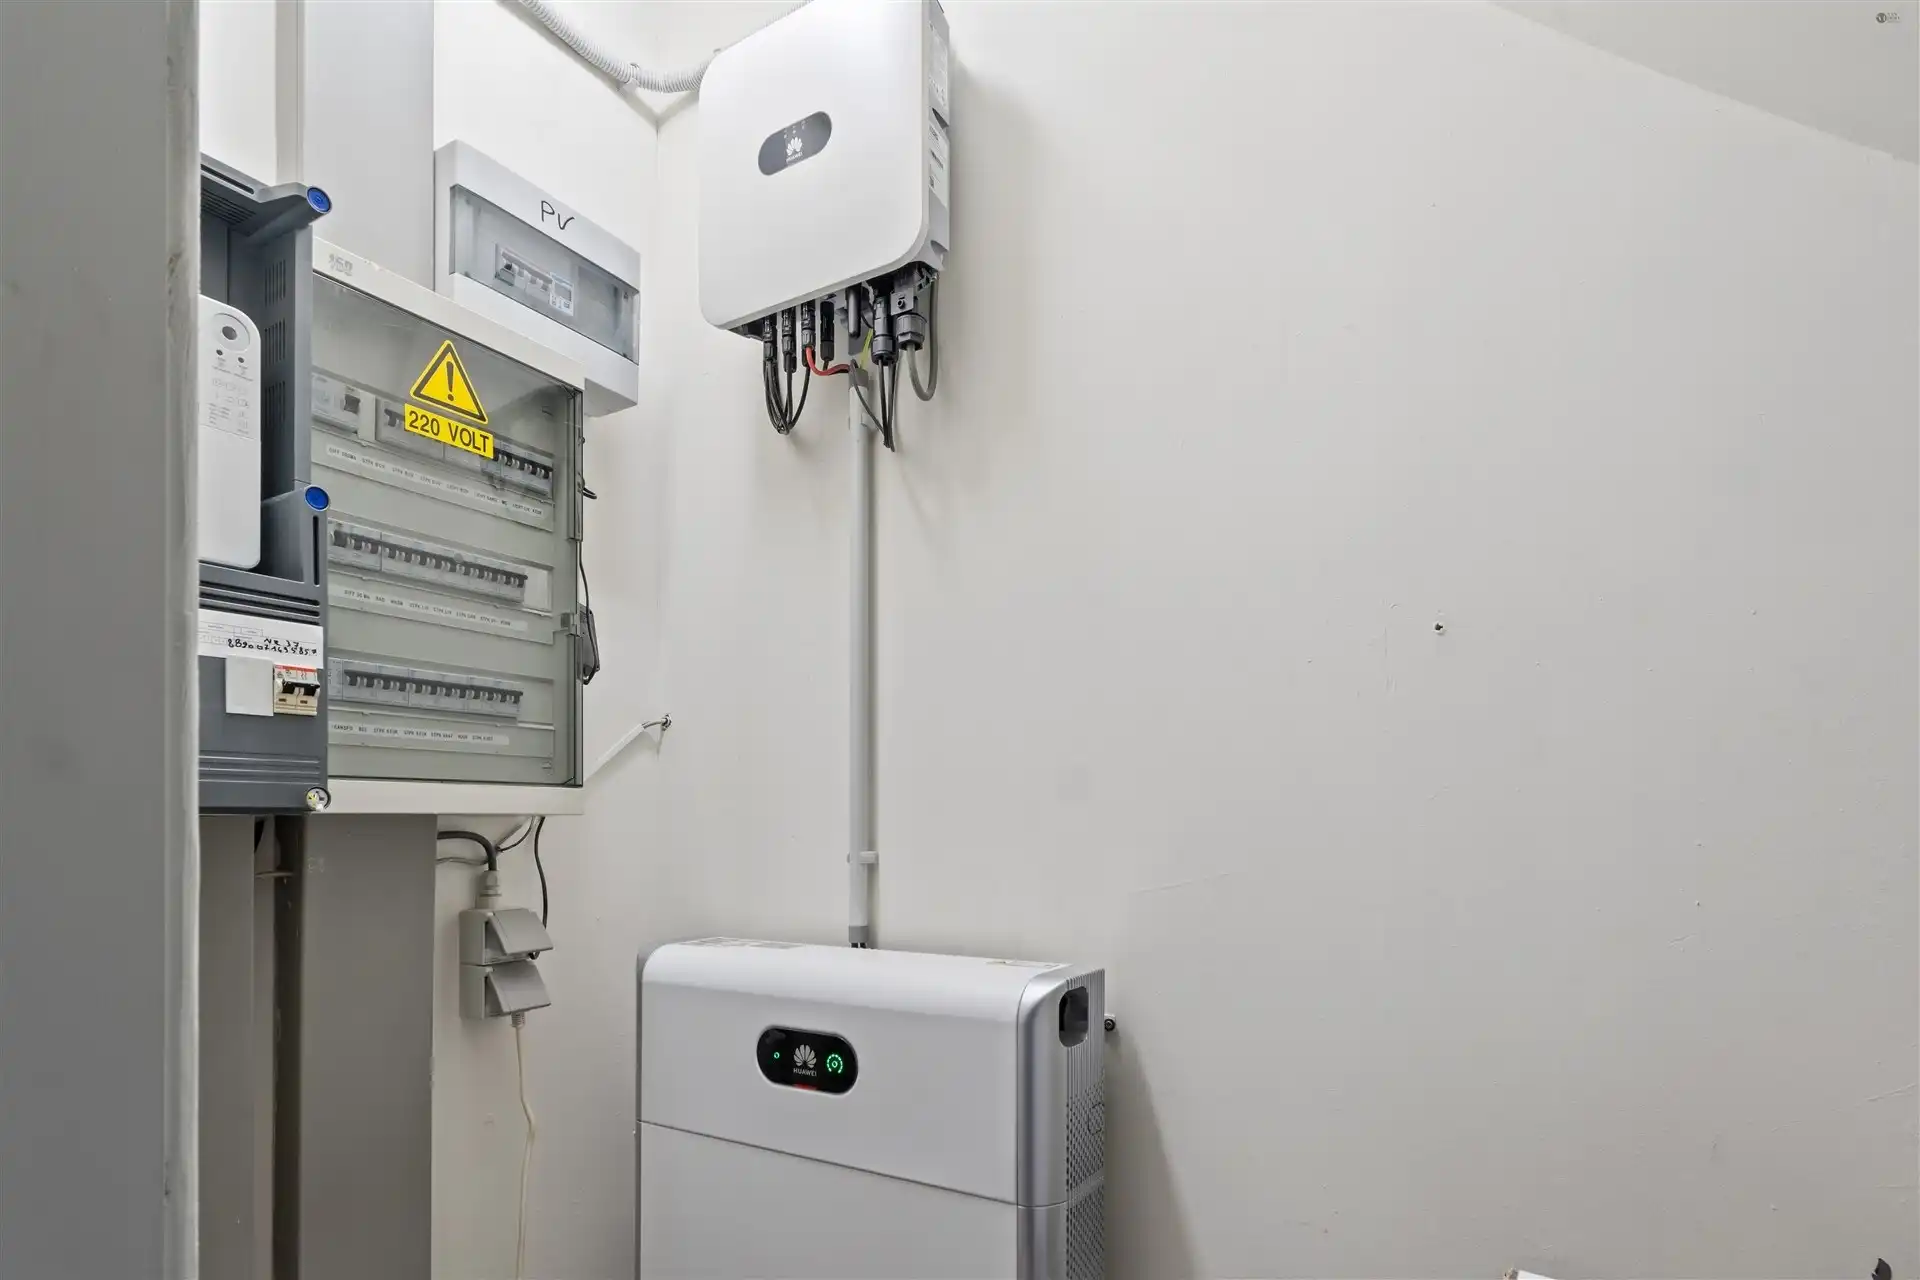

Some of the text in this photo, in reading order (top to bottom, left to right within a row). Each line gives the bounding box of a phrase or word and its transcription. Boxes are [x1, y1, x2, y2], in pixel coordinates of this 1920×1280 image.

[408, 410, 489, 453] 220 VOLT
[793, 1068, 817, 1077] HUAWEI
